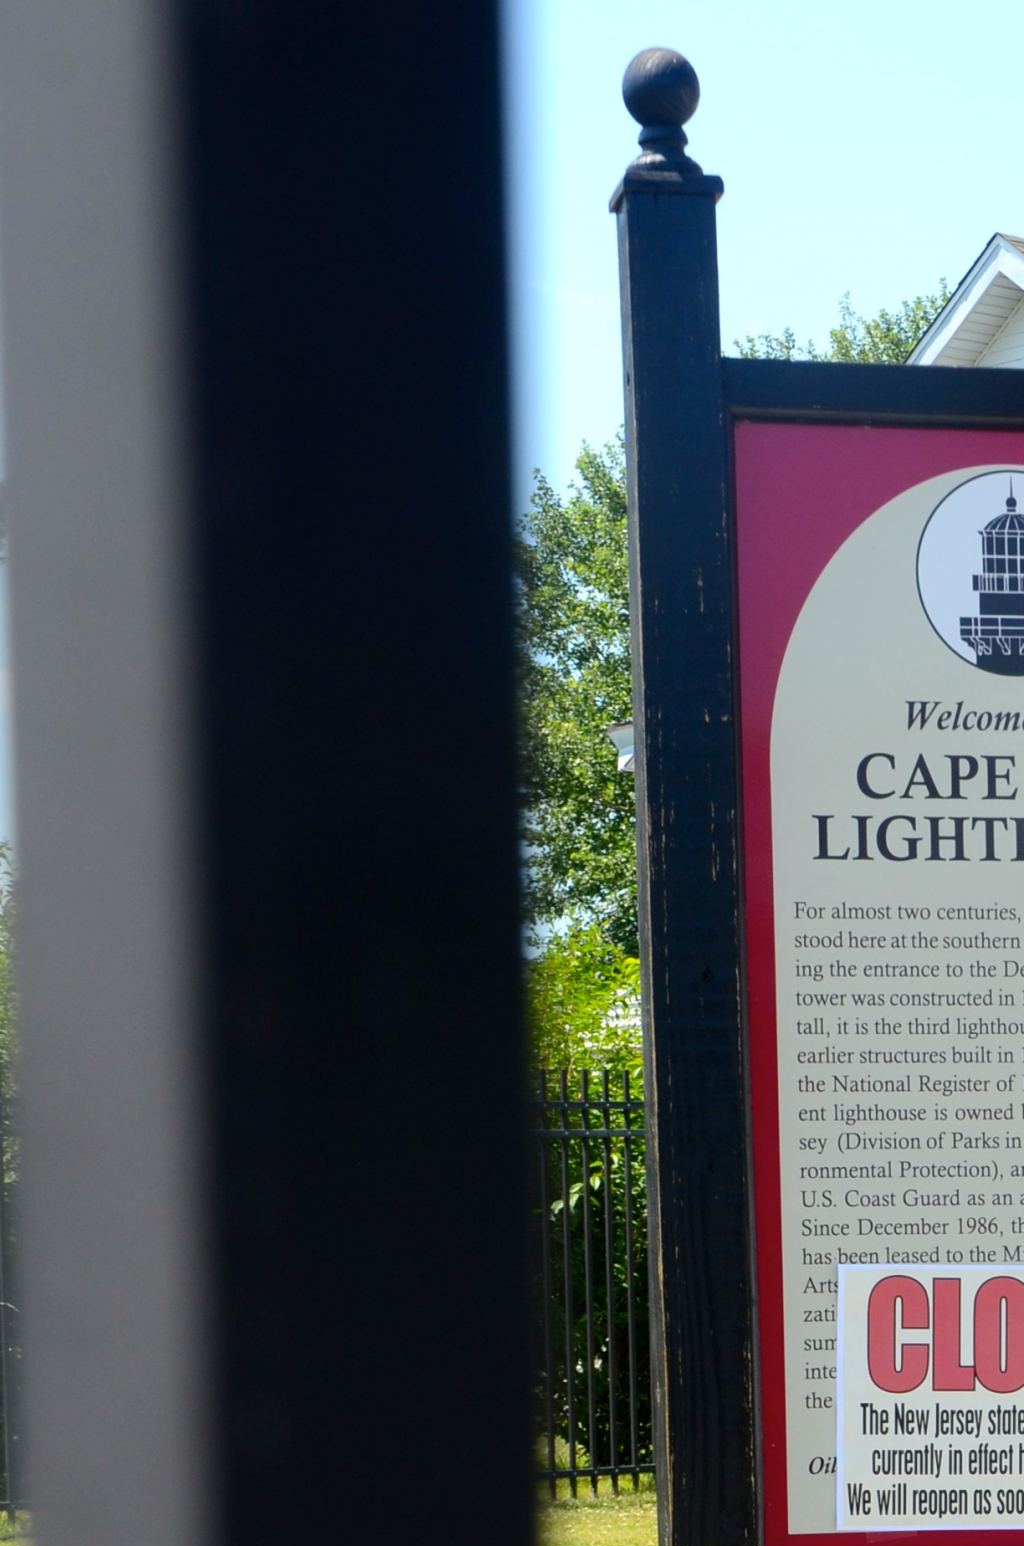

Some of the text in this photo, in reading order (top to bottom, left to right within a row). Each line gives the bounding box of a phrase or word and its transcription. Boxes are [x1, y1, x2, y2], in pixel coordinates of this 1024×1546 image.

[856, 752, 1019, 801] CAPE
[793, 900, 827, 920] For
[831, 901, 892, 921] almost
[897, 905, 931, 921] two
[936, 902, 1022, 924] centuries,
[794, 930, 844, 949] stood
[847, 930, 887, 949] here
[890, 934, 908, 949] at
[911, 930, 939, 949] the
[942, 931, 1021, 950] southern
[795, 958, 825, 983] ing
[829, 959, 858, 978] the
[862, 962, 940, 978] entrance
[945, 962, 964, 978] to
[969, 959, 997, 978] the
[795, 991, 848, 1007] tower
[851, 991, 886, 1007] was
[889, 988, 994, 1007] constructed
[998, 988, 1015, 1007] in
[796, 1017, 831, 1039] tall,
[836, 1016, 849, 1035] it
[855, 1016, 869, 1036] is
[874, 1017, 903, 1036] the
[907, 1016, 951, 1036] third
[796, 1045, 855, 1065] earlier
[859, 1049, 947, 1064] structures
[951, 1045, 993, 1064] built
[997, 1045, 1015, 1064] in
[797, 1074, 826, 1093] the
[831, 1074, 912, 1093] National
[918, 1074, 991, 1097] Register
[996, 1073, 1017, 1093] of
[798, 1106, 827, 1122] ent
[833, 1103, 927, 1127] lighthouse
[934, 1102, 948, 1121] is
[954, 1102, 1014, 1121] owned
[799, 1137, 828, 1155] sey
[837, 1131, 922, 1155] (Division
[926, 1131, 947, 1150] of
[951, 1131, 1001, 1150] Parks
[1005, 1130, 1022, 1149] in
[799, 1160, 893, 1180] ronmental
[898, 1159, 1004, 1182] Protection),
[800, 1189, 837, 1209] U.S.
[844, 1189, 897, 1208] Coast
[902, 1188, 961, 1208] Guard
[967, 1193, 986, 1207] as
[991, 1193, 1013, 1206] an
[801, 1218, 850, 1237] Since
[857, 1217, 950, 1236] December
[957, 1216, 1004, 1238] 1986,
[801, 1247, 833, 1266] has
[837, 1247, 880, 1265] been
[885, 1245, 940, 1265] leased
[946, 1248, 964, 1264] to
[968, 1244, 997, 1264] the
[802, 1304, 837, 1323] zati
[804, 1362, 837, 1380] inte
[805, 1392, 833, 1409] the
[859, 1402, 890, 1436] The
[894, 1402, 930, 1436] New
[934, 1402, 983, 1439] Jersey
[871, 1442, 943, 1479] currently
[948, 1443, 963, 1476] in
[968, 1442, 1014, 1476] effect
[847, 1482, 872, 1516] We
[876, 1482, 907, 1516] will
[912, 1489, 968, 1519] reopen
[973, 1488, 992, 1515] as
